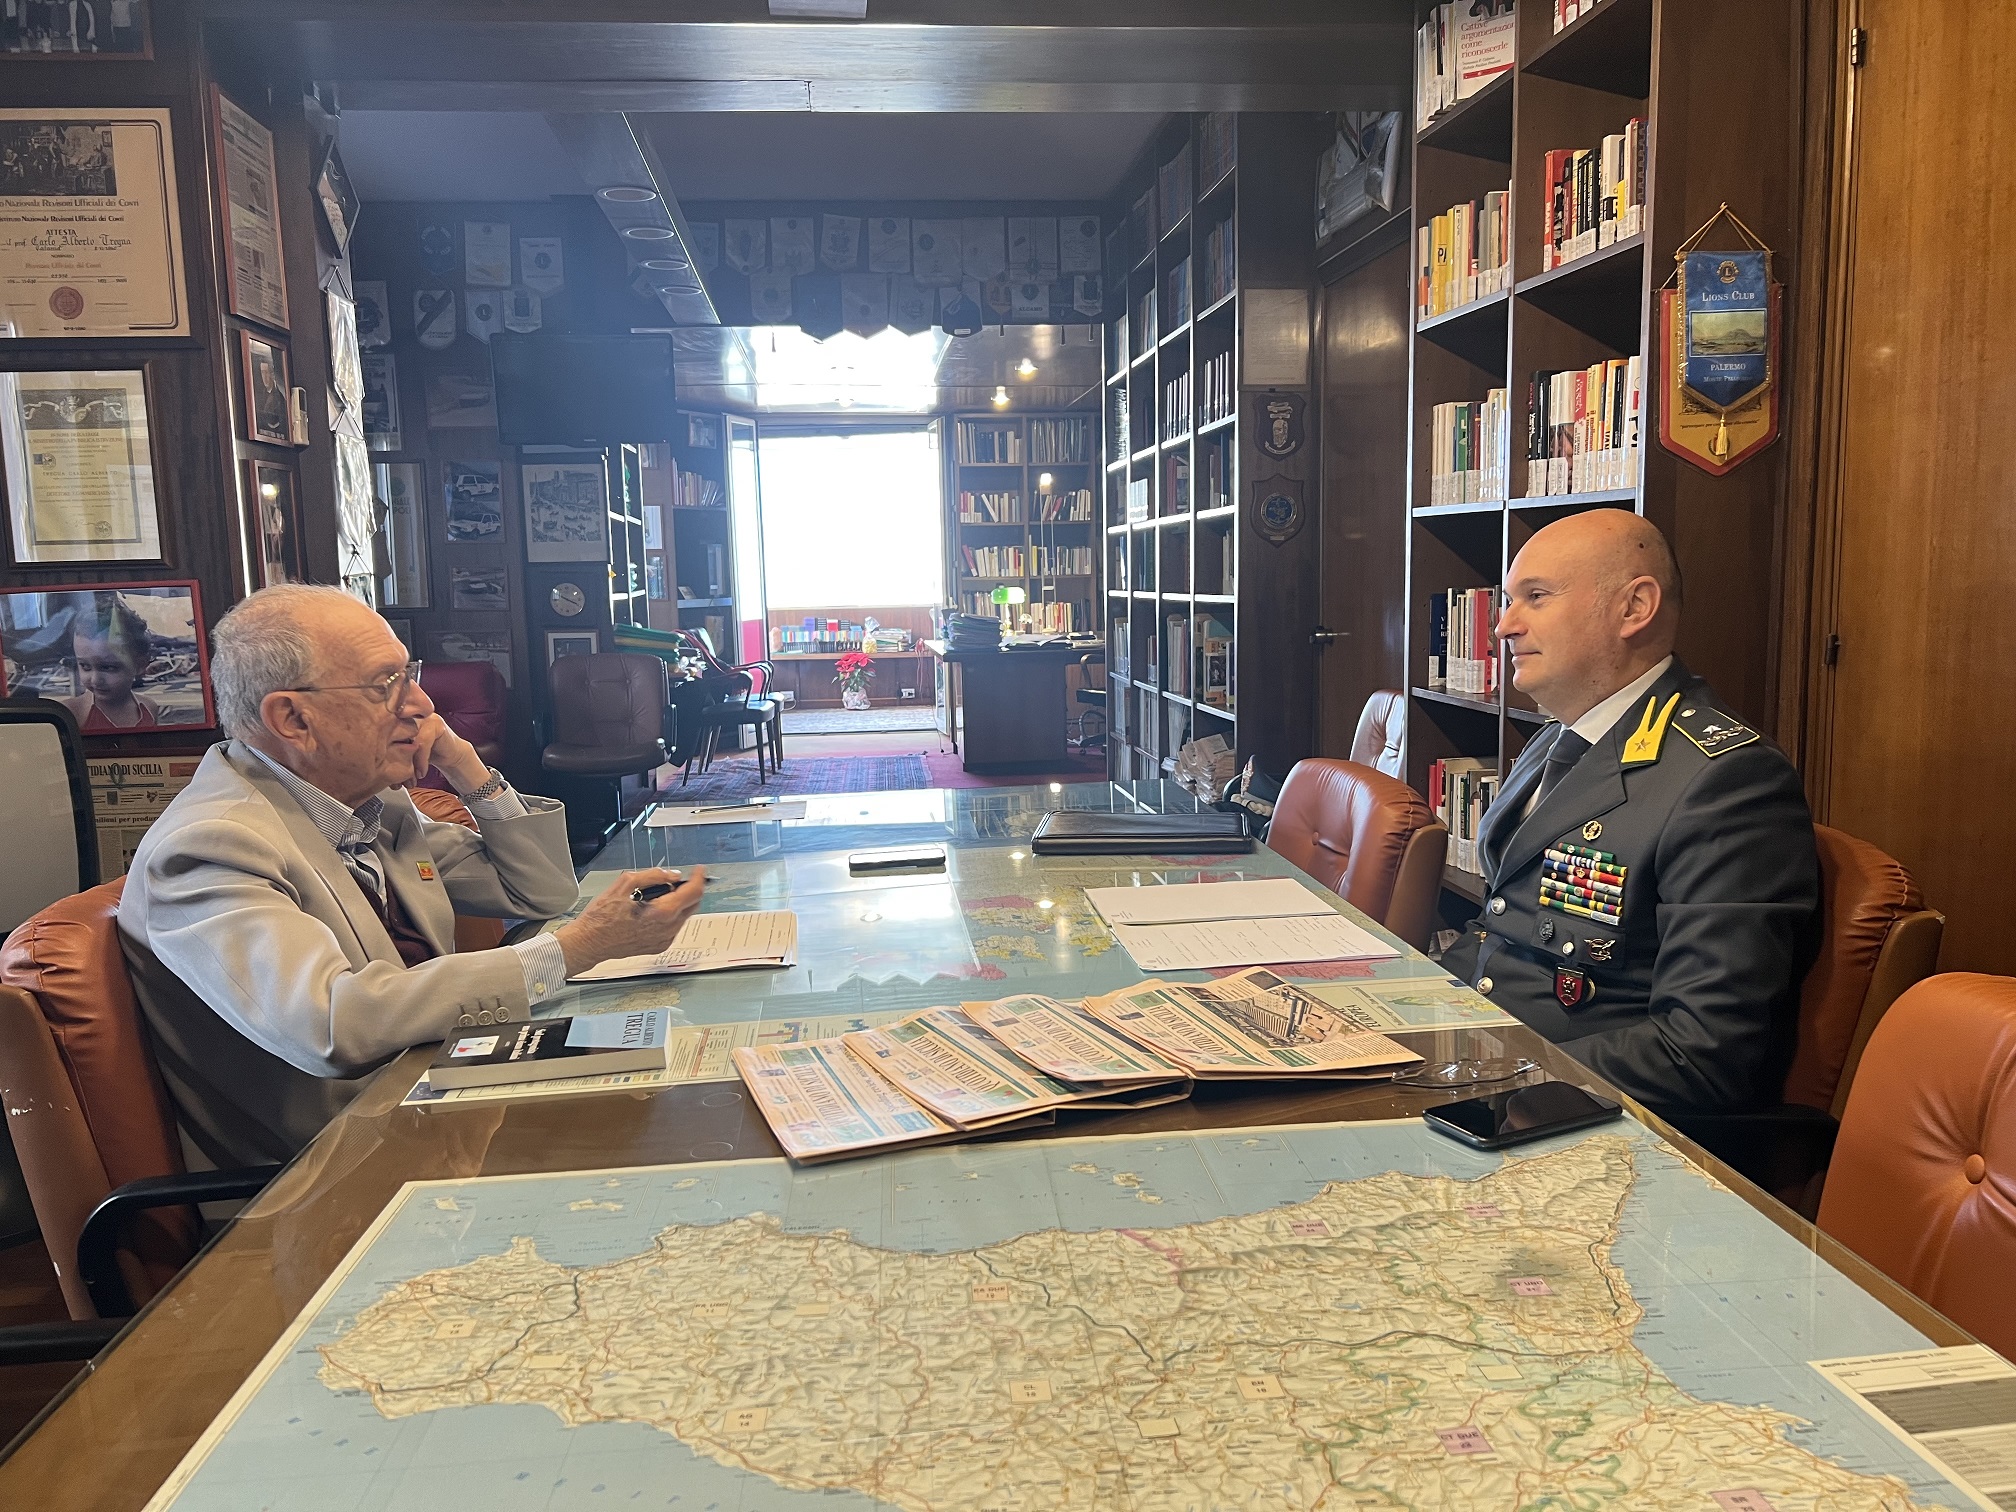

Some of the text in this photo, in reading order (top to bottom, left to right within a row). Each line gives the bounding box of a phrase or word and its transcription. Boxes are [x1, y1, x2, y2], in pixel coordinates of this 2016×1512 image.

[1461, 40, 1482, 50] come
[1461, 41, 1508, 59] riconoscerle
[31, 236, 56, 246] Carlo
[61, 236, 95, 246] Alberto
[1710, 363, 1747, 371] PALERMO
[121, 765, 130, 775] DI
[132, 764, 163, 775] SICILIA
[621, 1012, 644, 1045] TREGUA
